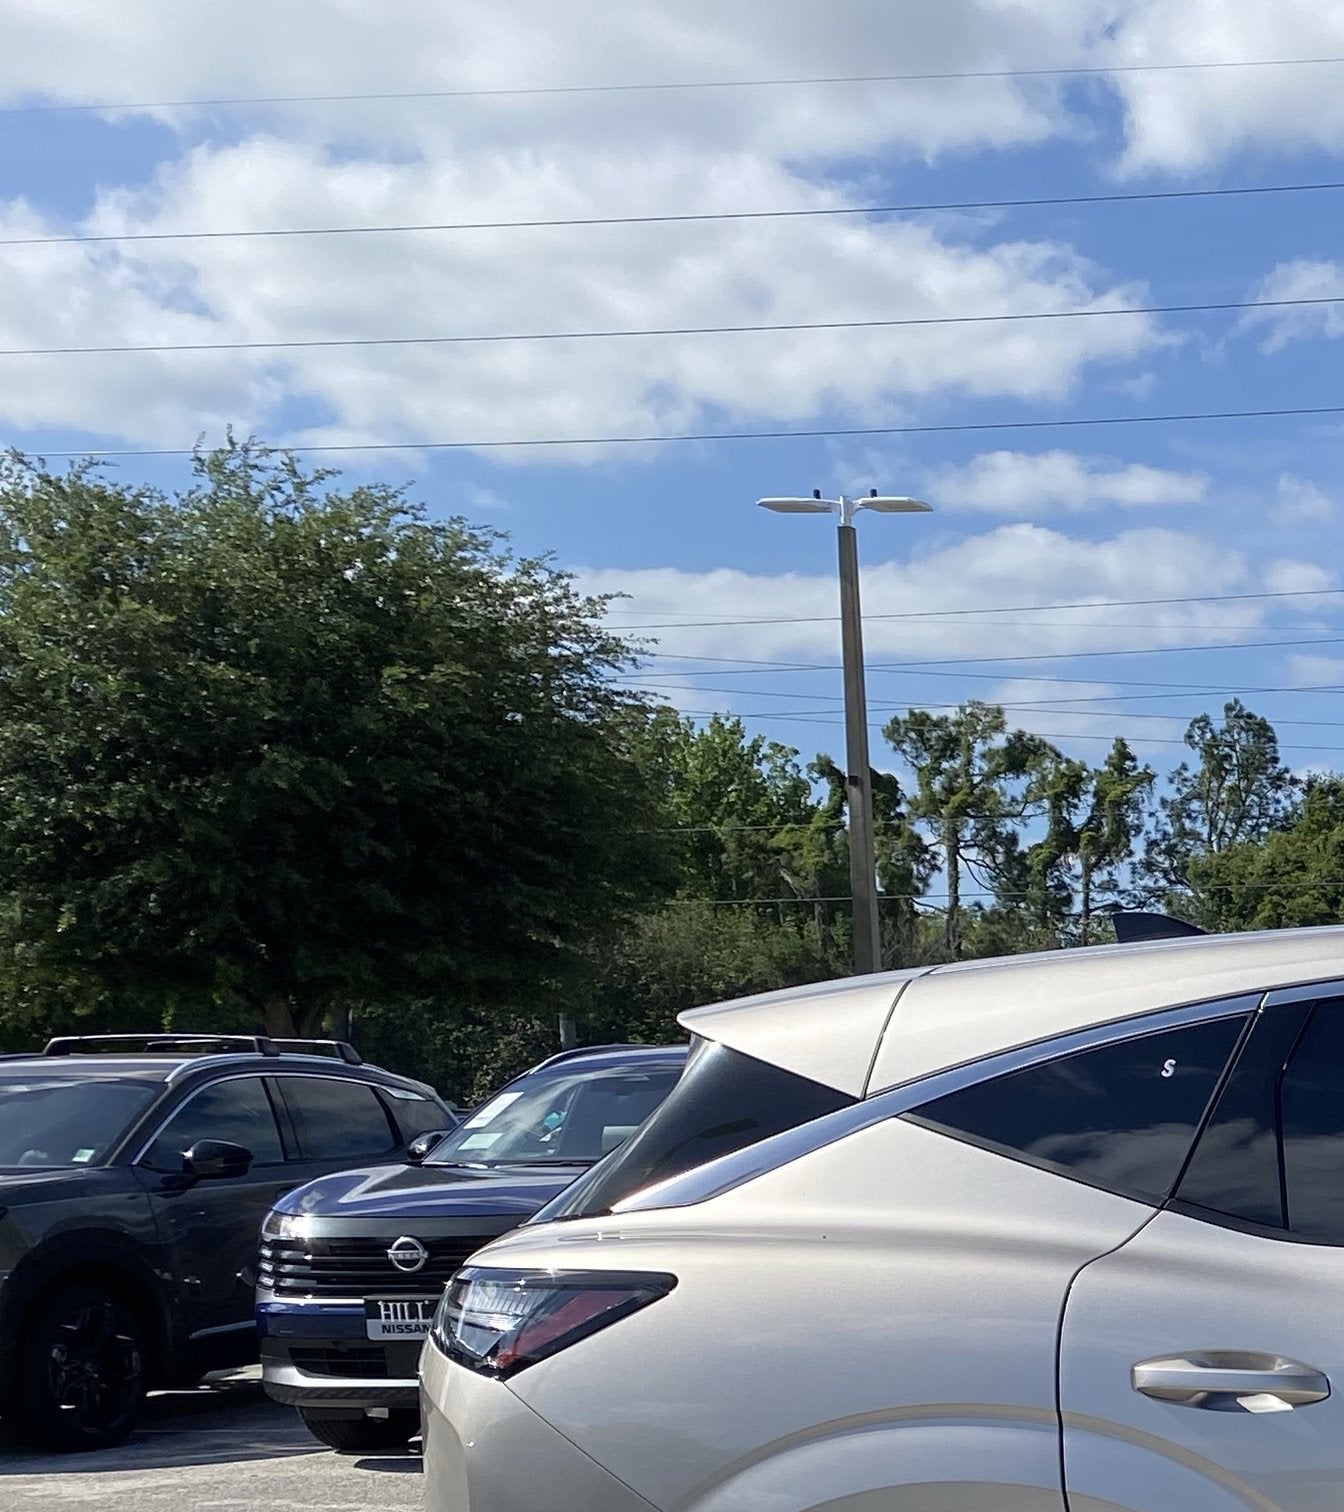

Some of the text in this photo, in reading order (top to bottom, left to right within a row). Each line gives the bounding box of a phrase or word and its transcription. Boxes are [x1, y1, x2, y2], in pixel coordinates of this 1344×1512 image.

[1161, 1059, 1177, 1078] S
[378, 1301, 433, 1322] HILL
[381, 1324, 431, 1335] NISSAN
